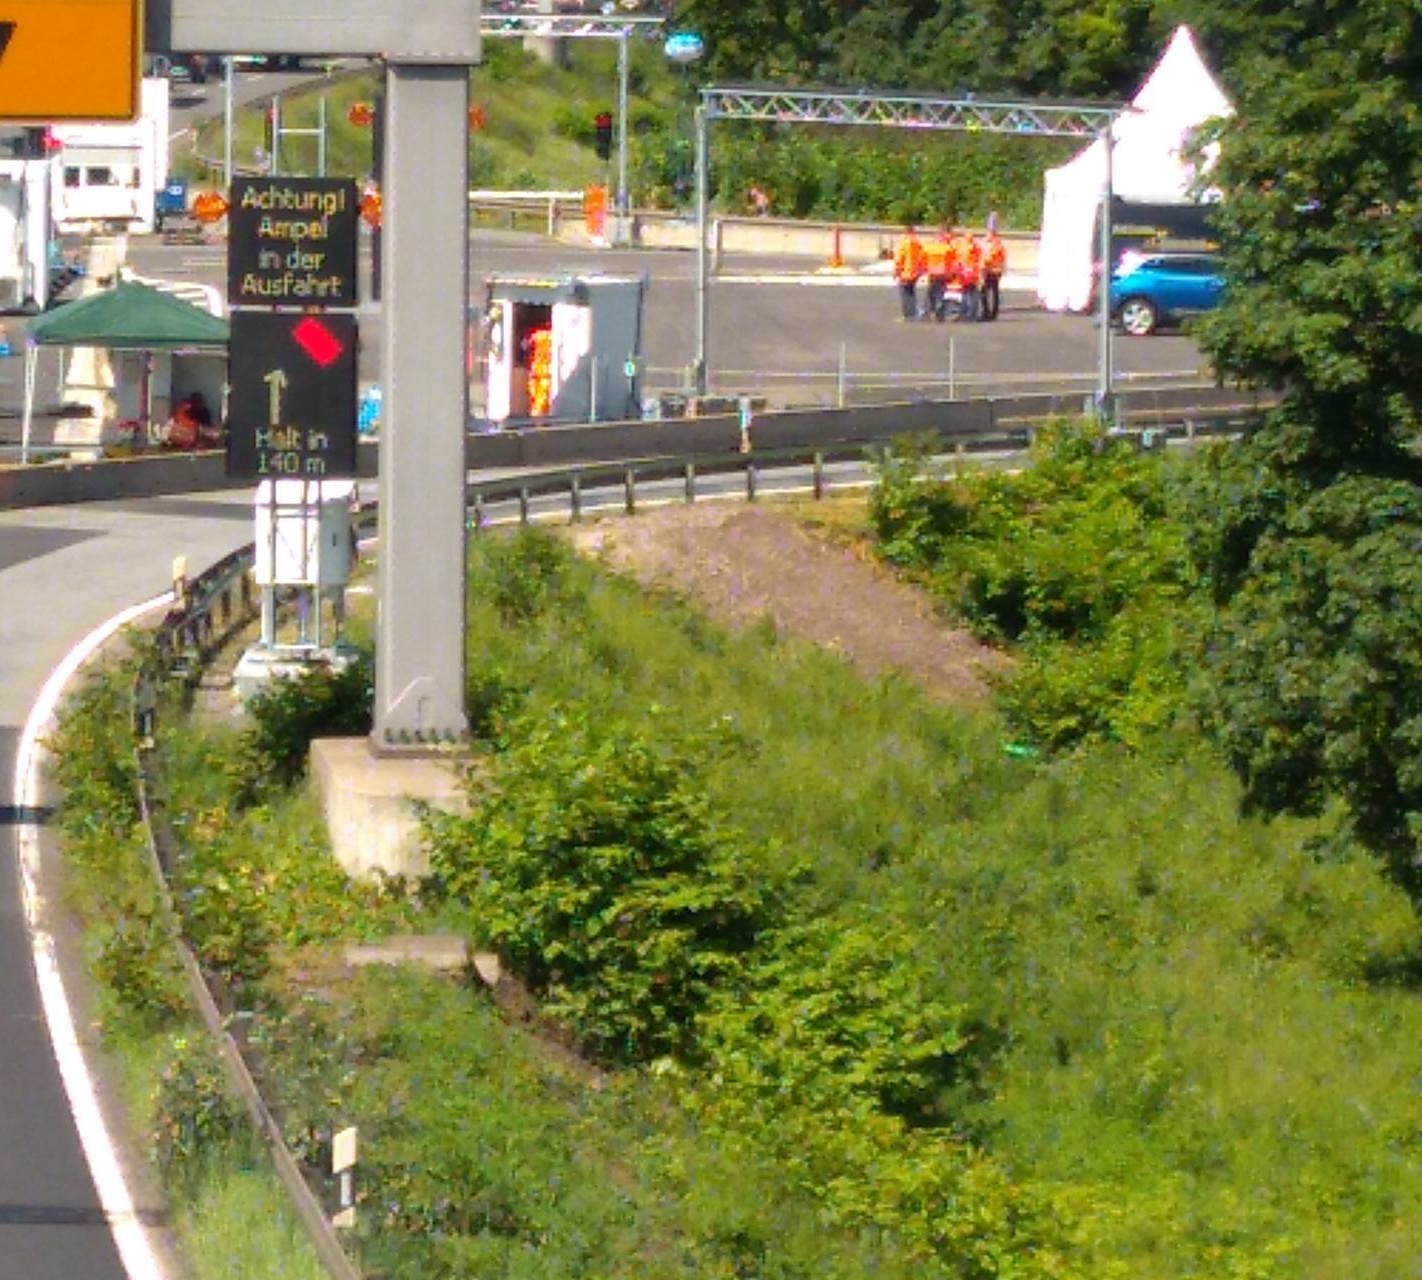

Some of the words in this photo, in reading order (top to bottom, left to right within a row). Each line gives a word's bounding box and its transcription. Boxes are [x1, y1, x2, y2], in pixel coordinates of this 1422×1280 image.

[241, 185, 345, 216] Achtung!
[257, 215, 328, 243] Ampel
[259, 247, 281, 269] in
[286, 245, 326, 270] der
[241, 271, 343, 297] Ausfahrt
[255, 427, 302, 450] Halt
[307, 429, 328, 451] in
[257, 452, 299, 474] 140
[306, 458, 326, 474] m
